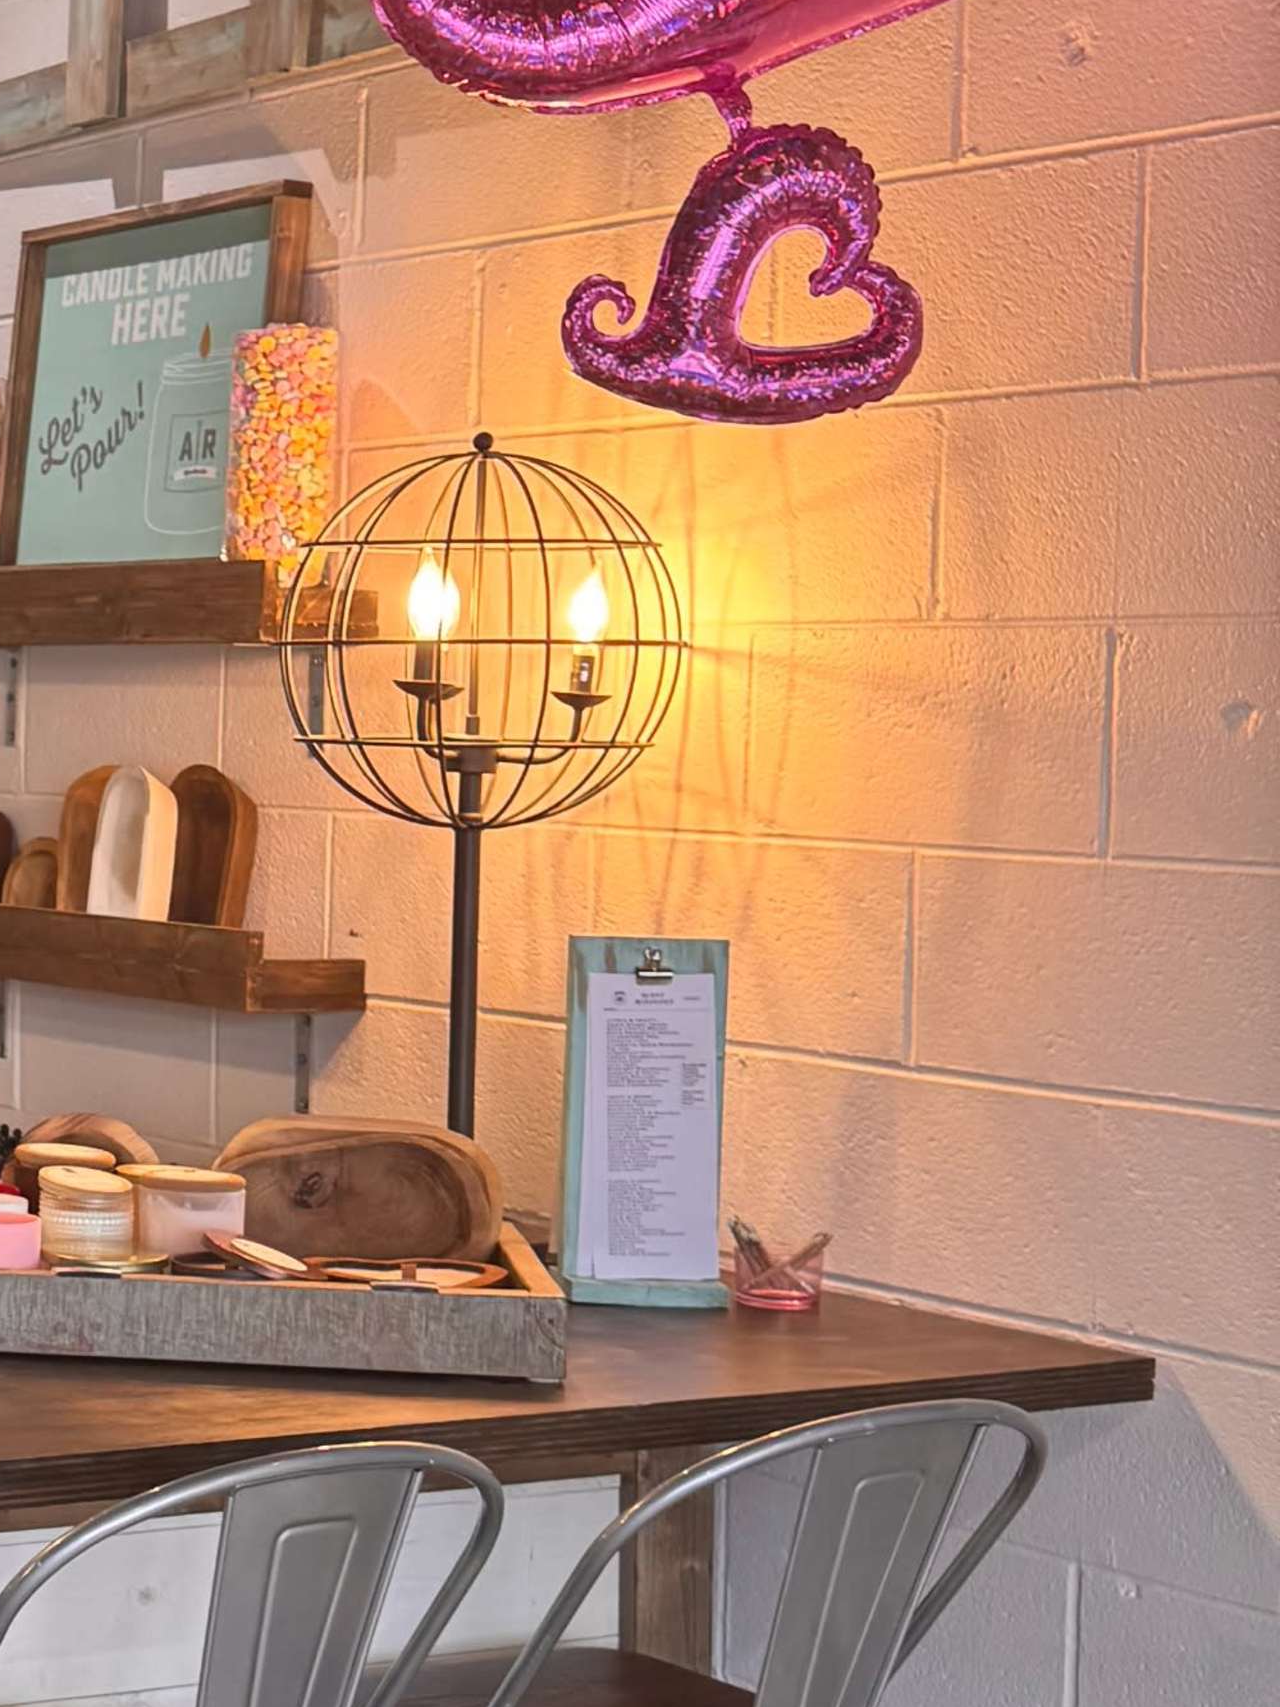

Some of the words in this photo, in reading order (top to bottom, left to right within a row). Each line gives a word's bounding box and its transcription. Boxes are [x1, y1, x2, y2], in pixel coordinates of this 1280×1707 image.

[61, 262, 151, 307] CANDLE
[156, 243, 254, 292] MAKING
[111, 293, 191, 345] HERE
[38, 386, 104, 476] Let's
[70, 379, 145, 492] Pour!
